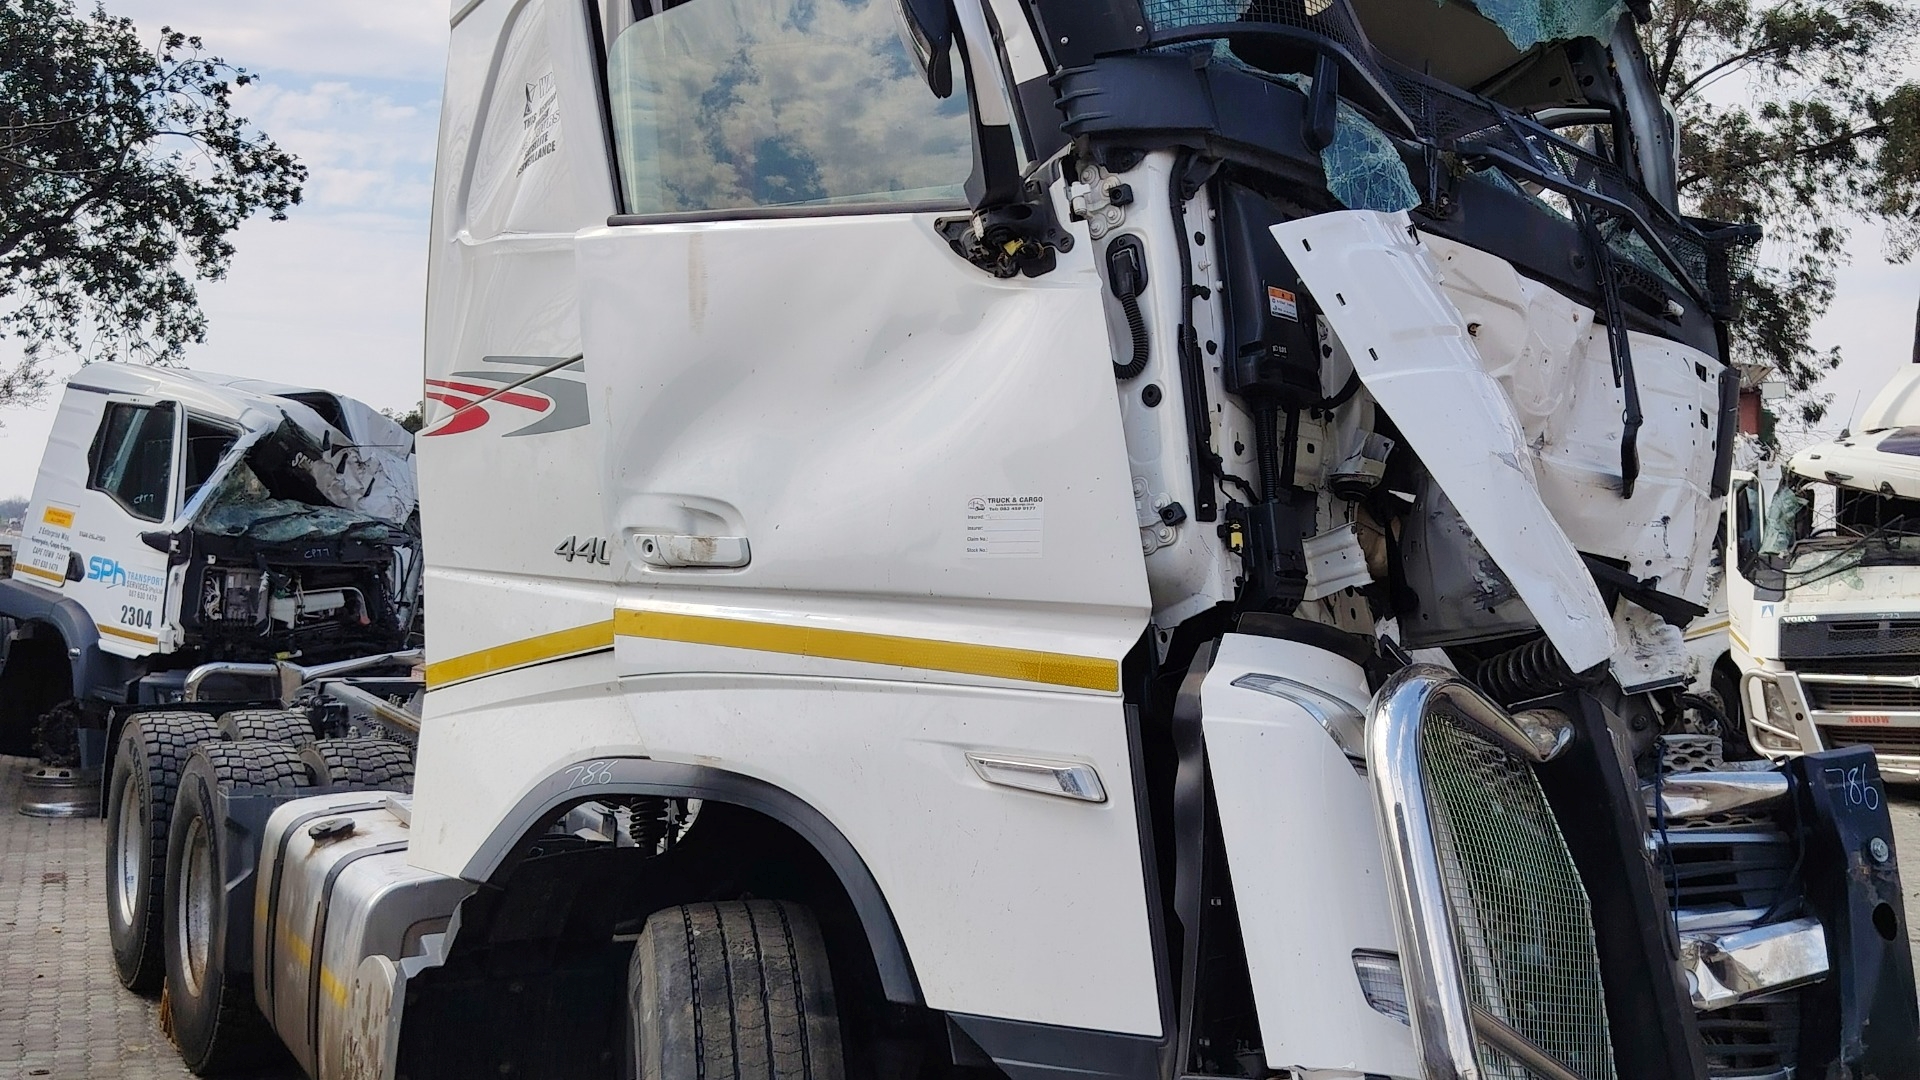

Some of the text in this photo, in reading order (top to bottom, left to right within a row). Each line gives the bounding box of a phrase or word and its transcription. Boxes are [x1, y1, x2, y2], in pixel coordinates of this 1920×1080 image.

[42, 527, 61, 539] Enterprise
[32, 546, 43, 556] CAPE
[43, 548, 55, 559] TOWN
[128, 571, 165, 587] TRANSPORT
[126, 581, 149, 592] SERVICES
[121, 605, 153, 629] 2304
[1783, 615, 1817, 623] VOLVO
[1847, 715, 1890, 724] ARROW
[565, 760, 619, 790] 786
[1825, 763, 1879, 811] 786
